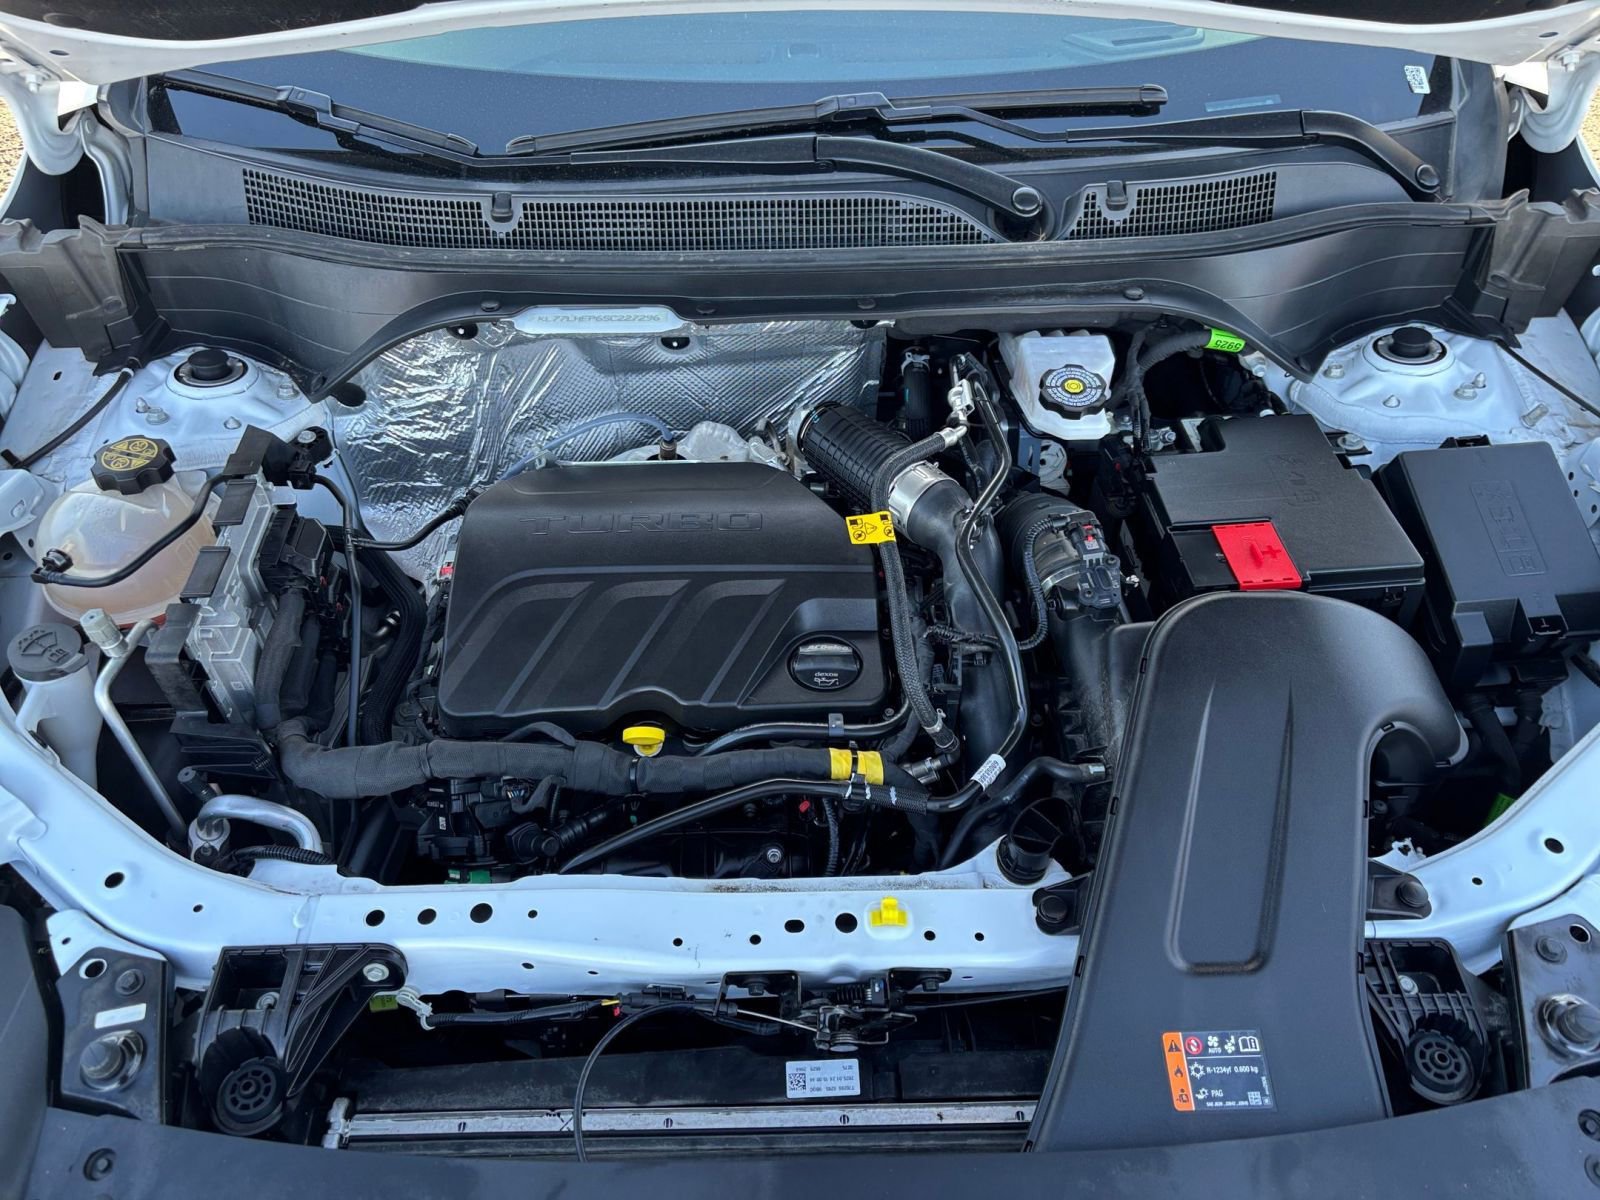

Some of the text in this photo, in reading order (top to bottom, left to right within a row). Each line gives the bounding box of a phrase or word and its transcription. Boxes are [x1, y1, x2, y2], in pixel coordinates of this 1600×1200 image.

[1213, 339, 1242, 351] 5925
[519, 512, 763, 536] TURBO
[1206, 1066, 1232, 1075] R-1234yf
